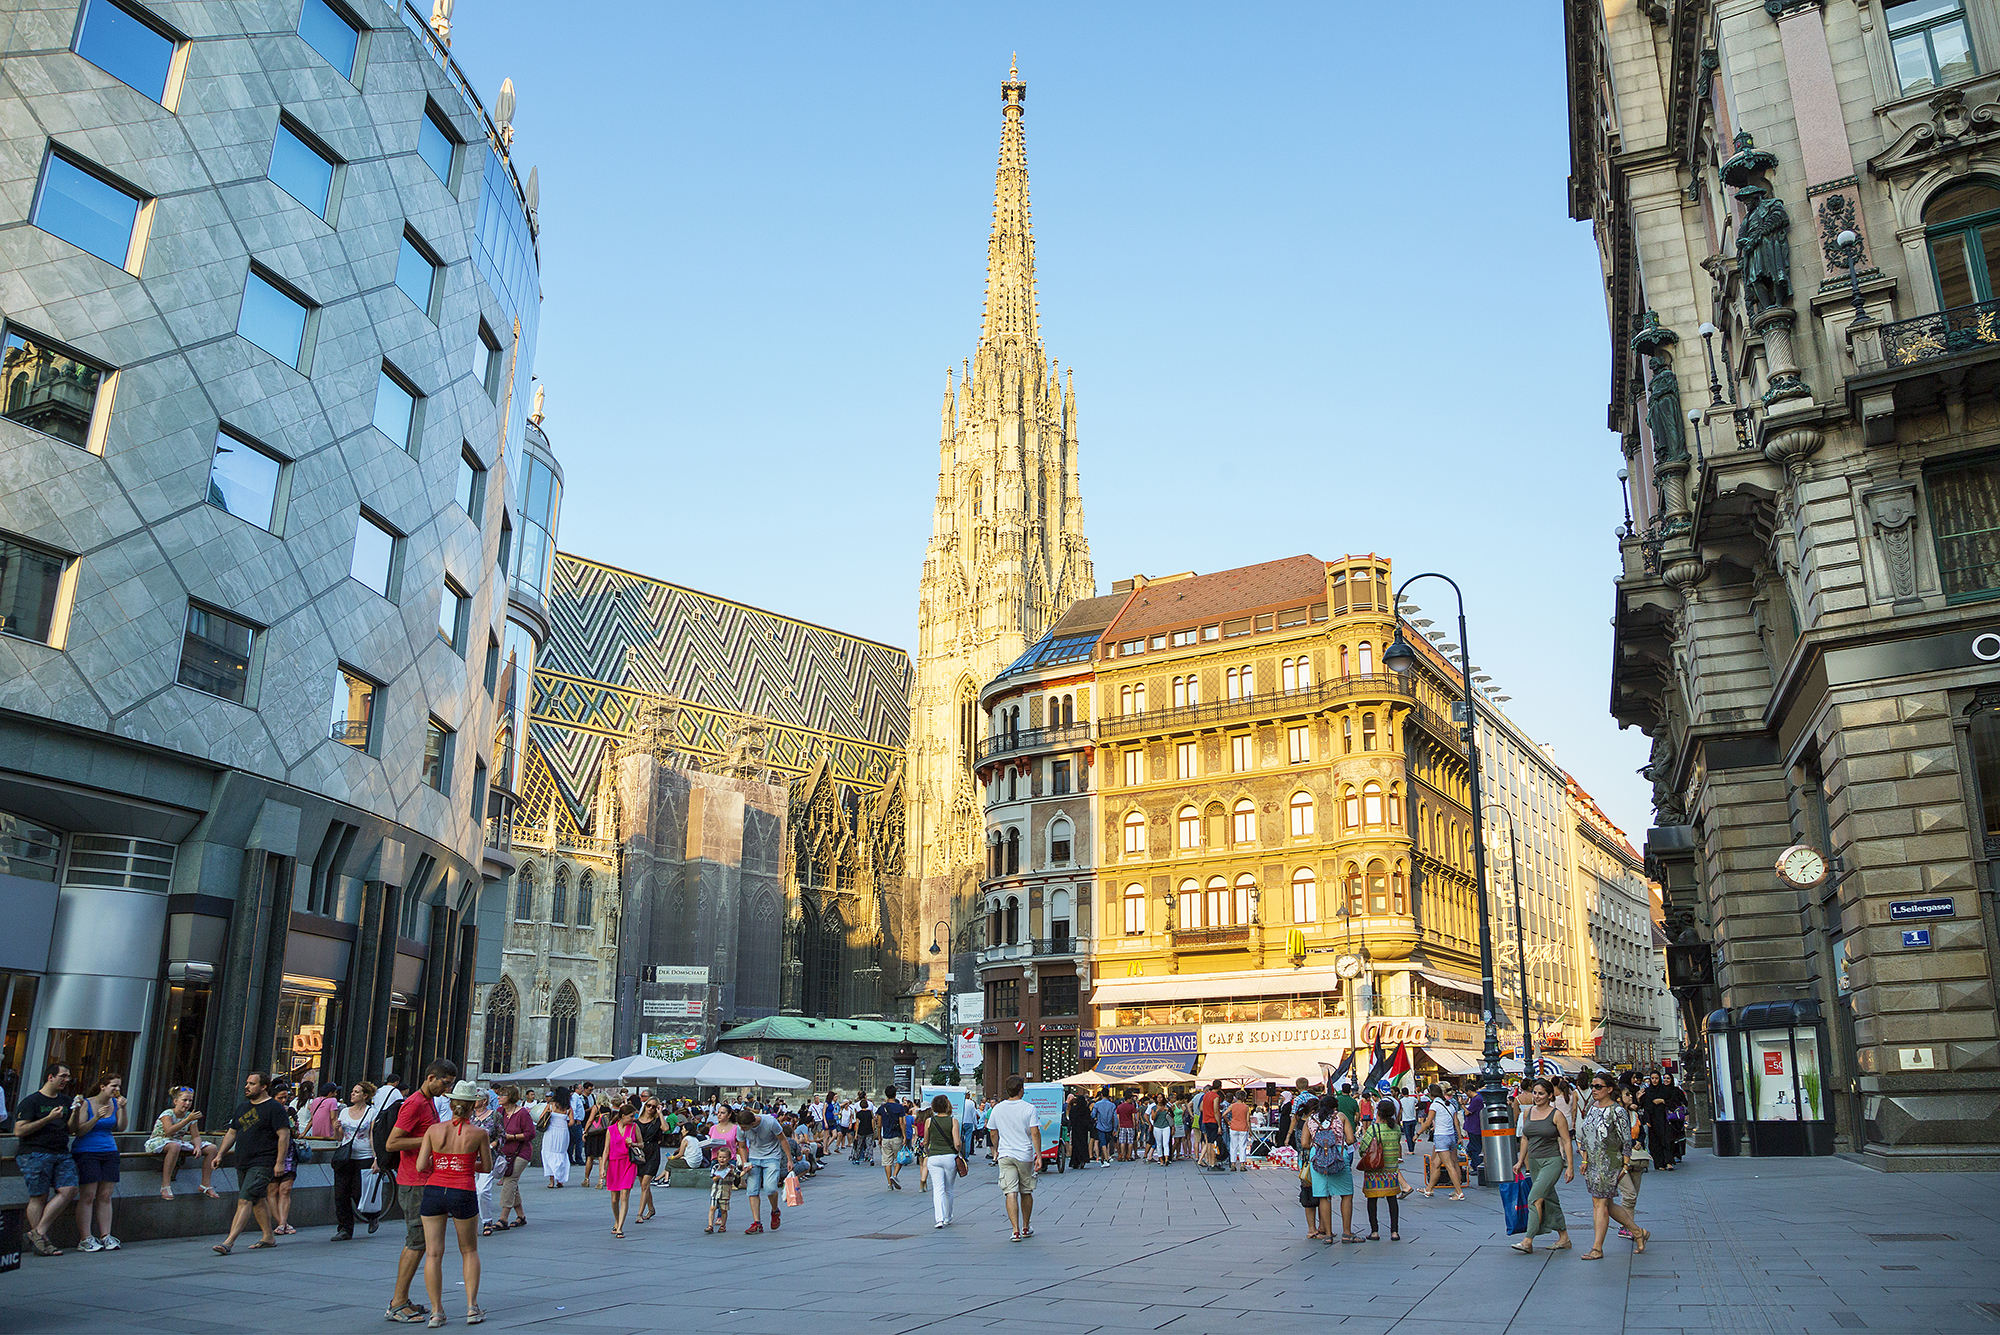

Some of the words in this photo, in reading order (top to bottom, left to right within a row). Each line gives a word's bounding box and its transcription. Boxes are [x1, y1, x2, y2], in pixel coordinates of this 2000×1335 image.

[1911, 932, 1920, 941] 1
[1207, 1031, 1244, 1045] CAFÉ
[1249, 1027, 1347, 1044] KONDITOREI
[1099, 1037, 1137, 1054] MONEY
[1139, 1034, 1198, 1052] EXCHANGE
[648, 1049, 673, 1058] MONET
[673, 1049, 685, 1058] BIS
[0, 1252, 19, 1266] NIC
